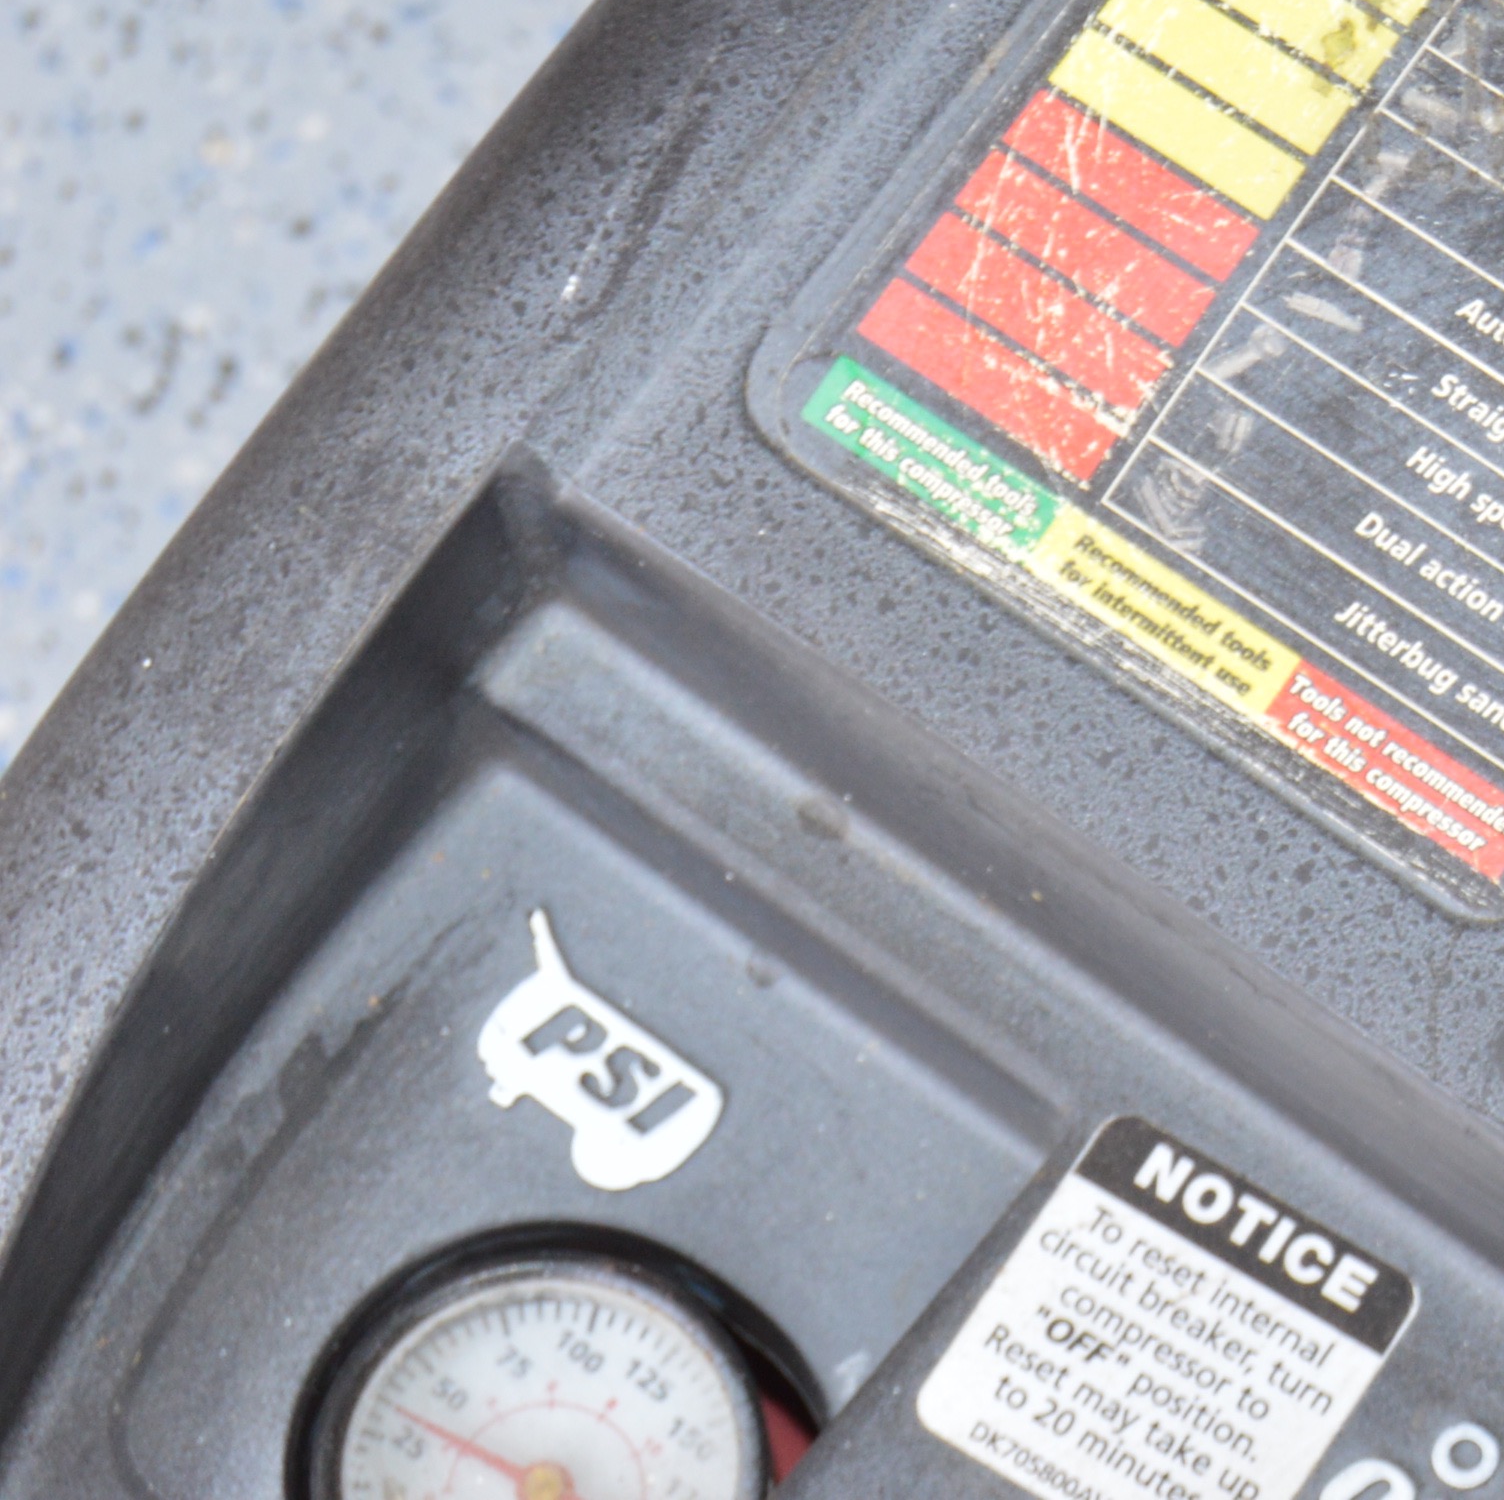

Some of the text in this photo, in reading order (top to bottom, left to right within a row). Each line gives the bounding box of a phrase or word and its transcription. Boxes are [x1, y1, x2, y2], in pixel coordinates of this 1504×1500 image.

[826, 404, 859, 433] for
[860, 428, 898, 461] this
[843, 381, 987, 487] Recommended
[1406, 446, 1471, 500] High
[1059, 560, 1250, 692] for intermittent use
[1075, 535, 1270, 670] Recommended tools
[1355, 512, 1426, 565] Dual
[1420, 559, 1502, 620] action
[1335, 602, 1458, 694] Jitterbug
[1290, 672, 1345, 721] Tools
[1344, 717, 1385, 747] not
[1288, 712, 1484, 850] for this compressor
[520, 1003, 699, 1136] PSI
[1089, 1205, 1335, 1368] To reset internal
[1136, 1145, 1375, 1309] NOTICE
[554, 1328, 606, 1374] 100
[624, 1357, 670, 1402] 125
[1039, 1229, 1333, 1415] circuit breaker, turn
[1060, 1286, 1270, 1420] compressor to
[430, 1374, 469, 1412] 50
[987, 1325, 1260, 1500] Reset may take up
[994, 1375, 1028, 1410] to
[1032, 1398, 1076, 1436] 20
[1038, 1306, 1130, 1365] "OFF"
[1126, 1372, 1256, 1462] position.
